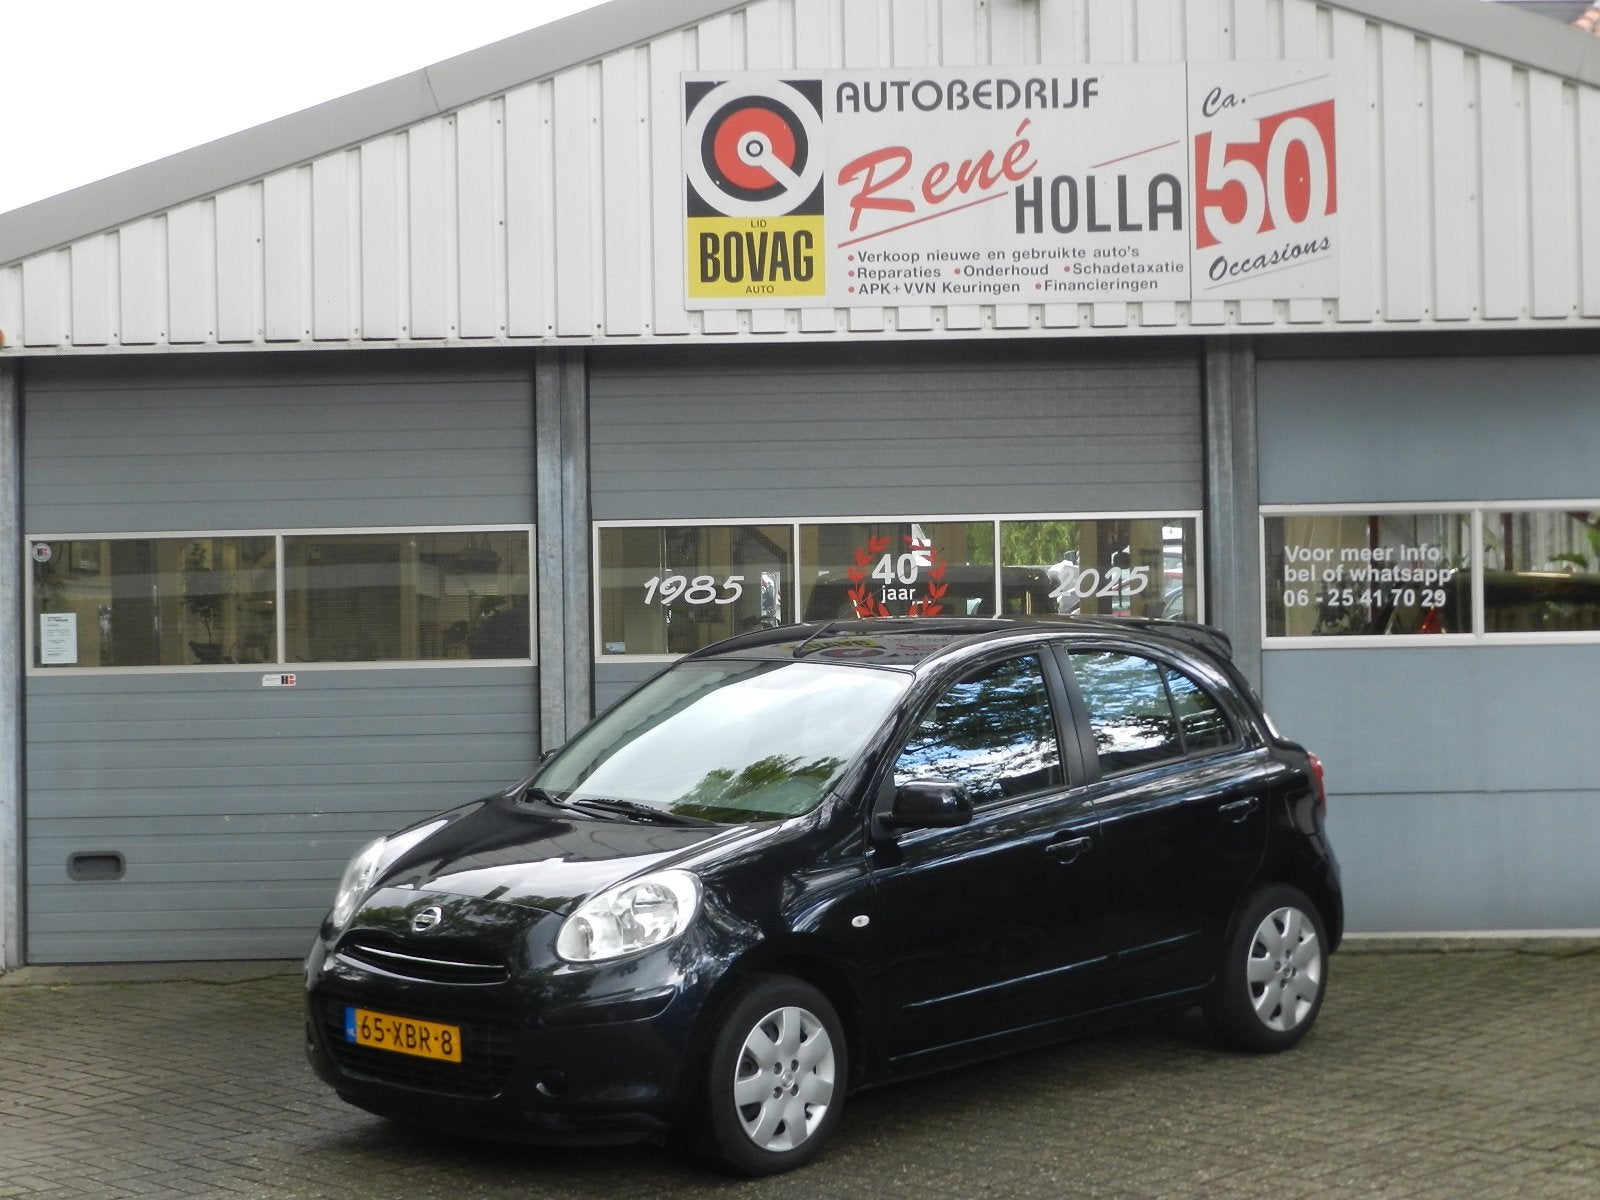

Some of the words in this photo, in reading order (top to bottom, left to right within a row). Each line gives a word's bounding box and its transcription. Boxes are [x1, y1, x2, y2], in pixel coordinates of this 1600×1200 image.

[836, 77, 1099, 113] AUTOBEDRIJF
[1202, 87, 1246, 118] Ca.
[838, 118, 1038, 232] René
[1202, 113, 1330, 245] 50
[1015, 173, 1183, 234] HOLLA
[750, 219, 767, 228] LID
[700, 229, 814, 284] BOVAG
[857, 250, 920, 264] Verkoop
[926, 250, 981, 261] nieuwe
[987, 250, 1006, 260] en
[1012, 247, 1086, 262] gebruikte
[1093, 245, 1140, 258] auto's
[1208, 236, 1331, 281] Occasions
[857, 267, 941, 281] Reparaties
[963, 264, 1049, 277] Onderhoud
[1072, 262, 1184, 275] Schadetaxatie
[745, 285, 775, 294] AUTO
[942, 281, 1020, 295] Keuringen
[1044, 278, 1158, 292] Financieringen
[1284, 546, 1333, 562] Voor
[1340, 548, 1393, 561] meer
[871, 553, 919, 585] 40
[1284, 565, 1316, 582] bel
[1323, 565, 1344, 582] of
[1349, 565, 1451, 585] whatsapp
[644, 575, 745, 605] 1985
[1049, 566, 1150, 599] 2025
[881, 585, 916, 603] jaar
[1283, 590, 1309, 607] 06
[1328, 589, 1354, 607] 25
[1360, 589, 1382, 606] 41
[1392, 589, 1415, 606] 70
[1421, 589, 1446, 608] 29
[361, 1015, 454, 1056] 65-XBR-8
